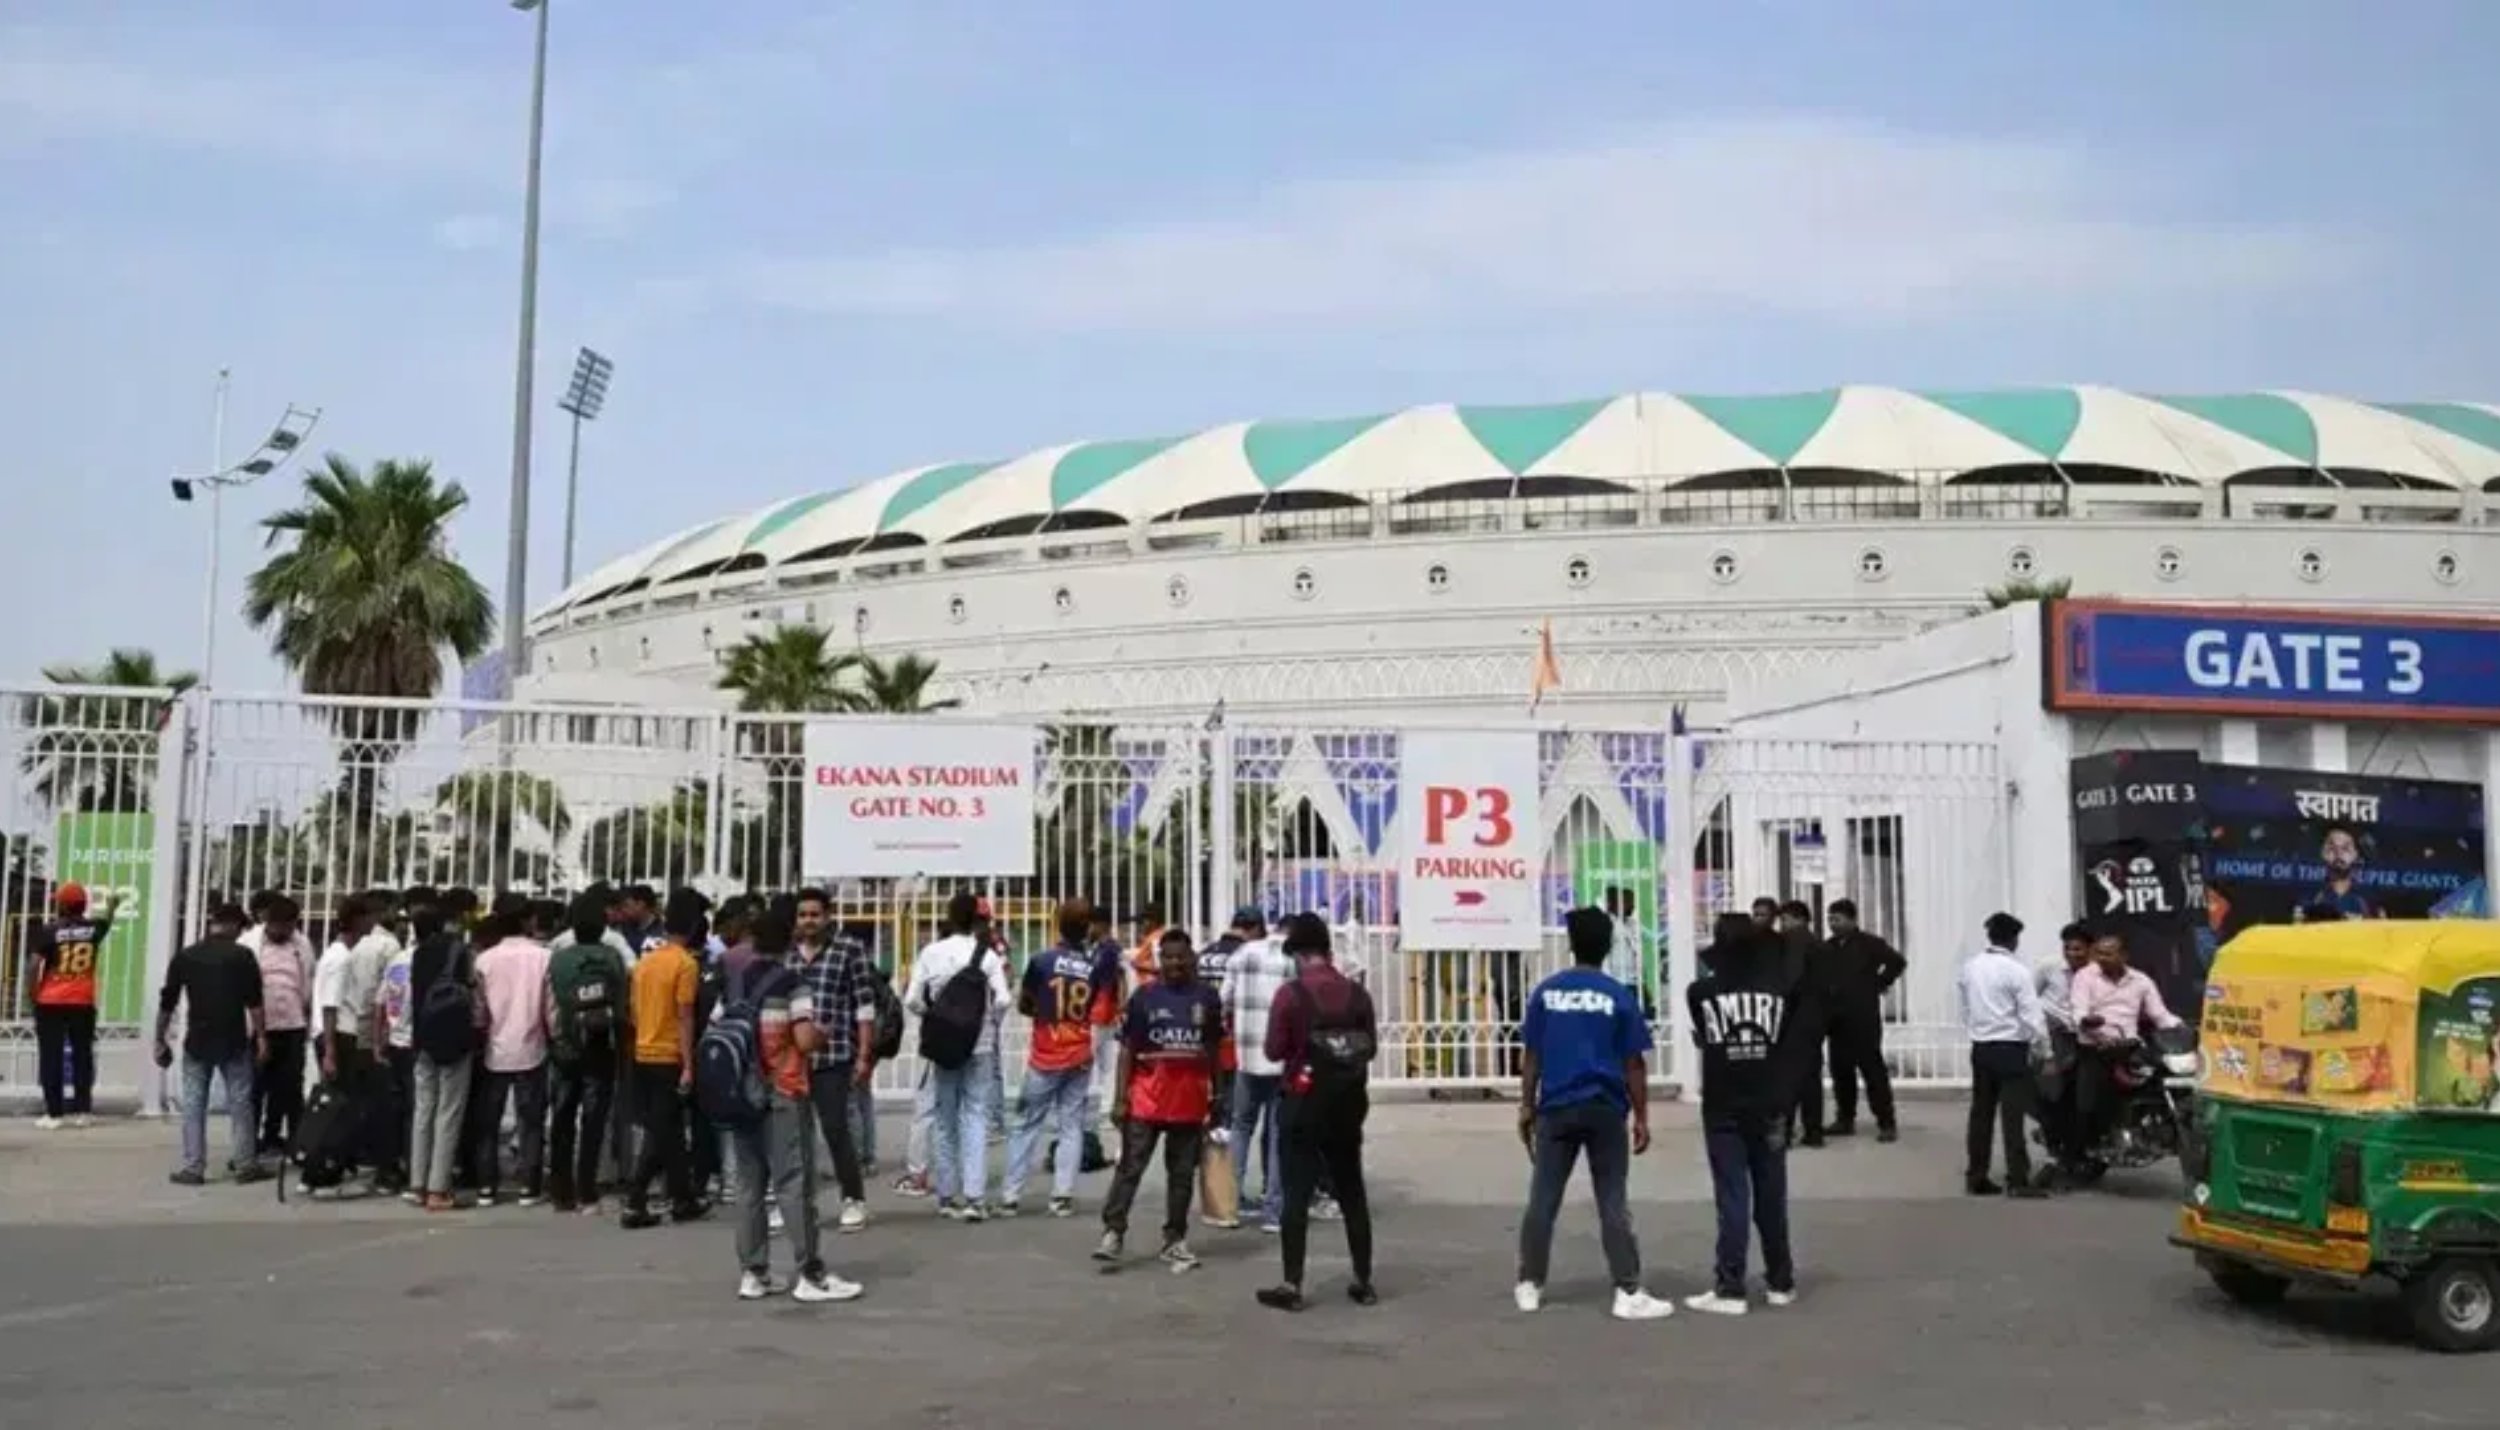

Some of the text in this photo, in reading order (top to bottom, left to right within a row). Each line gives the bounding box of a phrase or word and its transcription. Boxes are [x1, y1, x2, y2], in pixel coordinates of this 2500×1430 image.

[2183, 629, 2425, 694] GATE 3
[816, 766, 1019, 787] EKANA STADIUM
[850, 797, 985, 818] GATE NO. 3
[2076, 788, 2106, 809] GATE
[2125, 783, 2196, 803] GATE 3
[2295, 789, 2381, 823] स्वागत
[1425, 785, 1513, 847] P3
[1415, 857, 1526, 880] PARKING
[2214, 859, 2266, 878] HOME
[2271, 863, 2292, 880] OF
[2352, 869, 2398, 887] UPER
[2401, 872, 2461, 889] GIANTS
[2125, 885, 2174, 914] IPL
[58, 942, 95, 974] 18
[1047, 976, 1092, 1021] 18
[1701, 992, 1784, 1045] AMIRI
